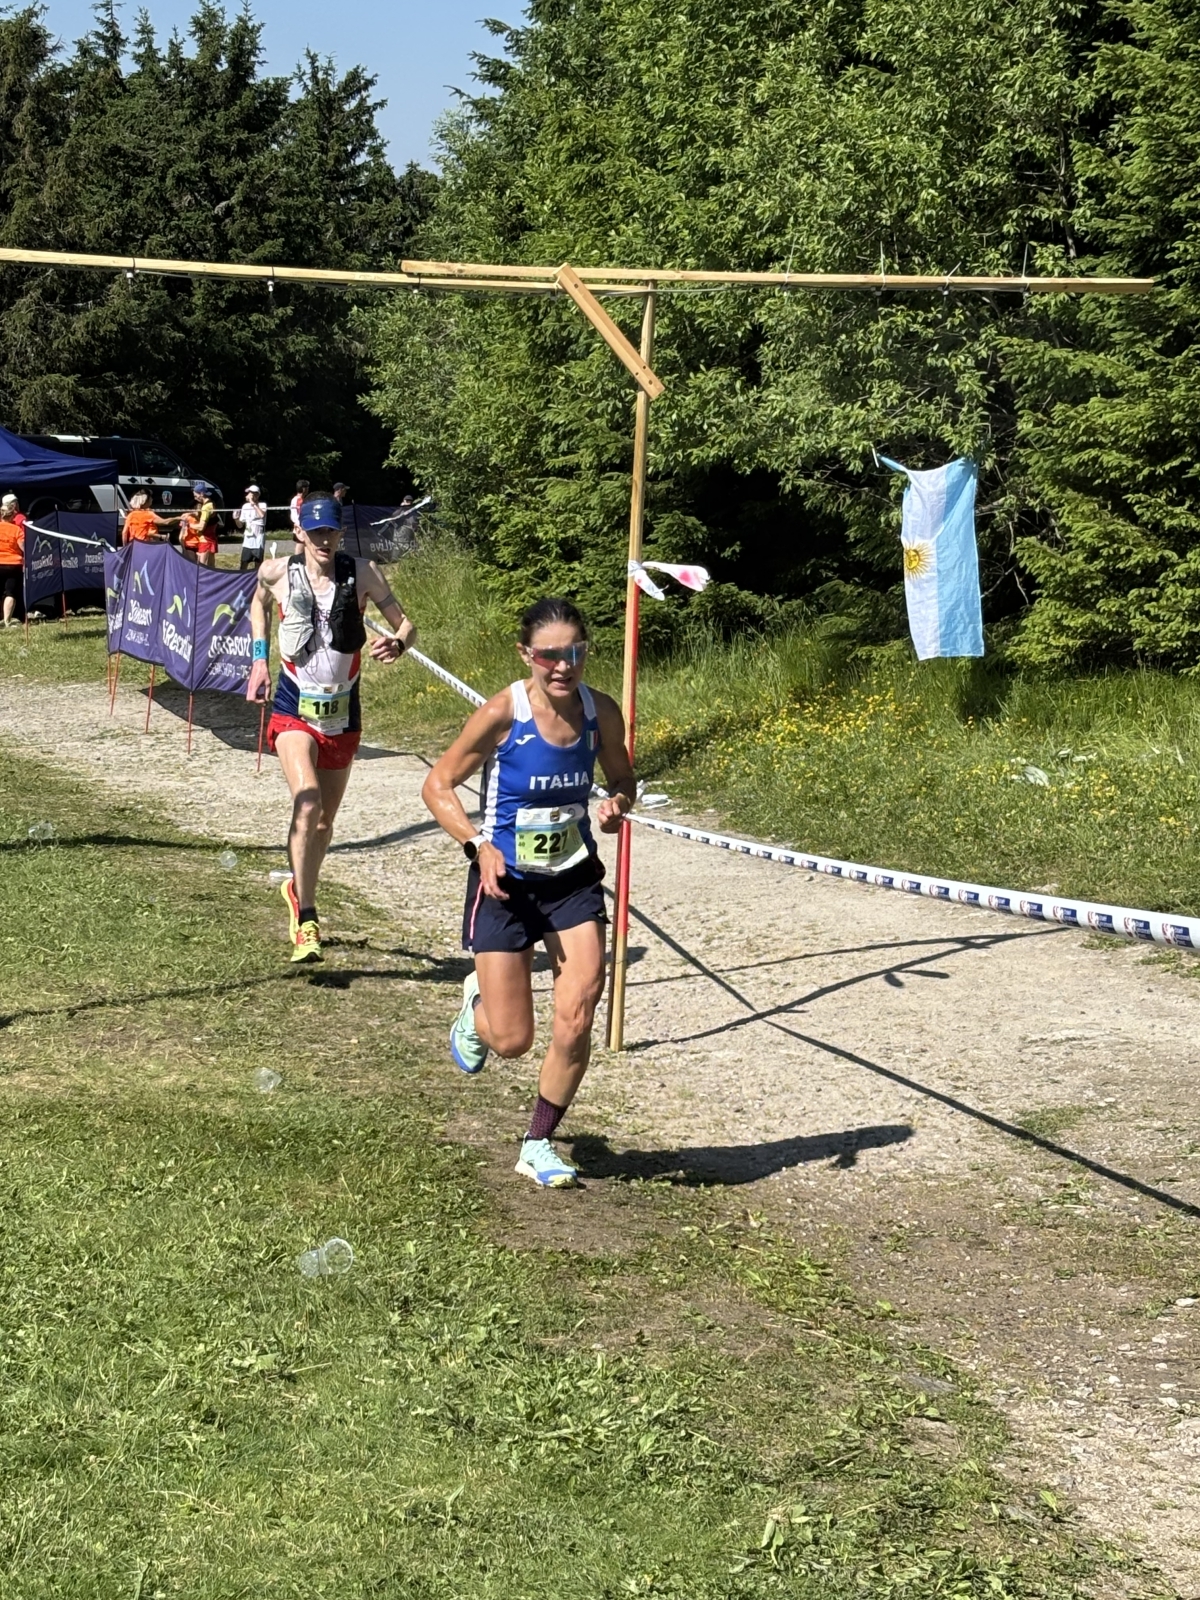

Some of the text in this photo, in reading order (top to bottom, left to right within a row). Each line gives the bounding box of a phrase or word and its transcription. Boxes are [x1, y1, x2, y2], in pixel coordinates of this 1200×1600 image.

[313, 700, 339, 715] 118
[529, 771, 590, 790] ITALIA
[533, 829, 568, 854] 227
